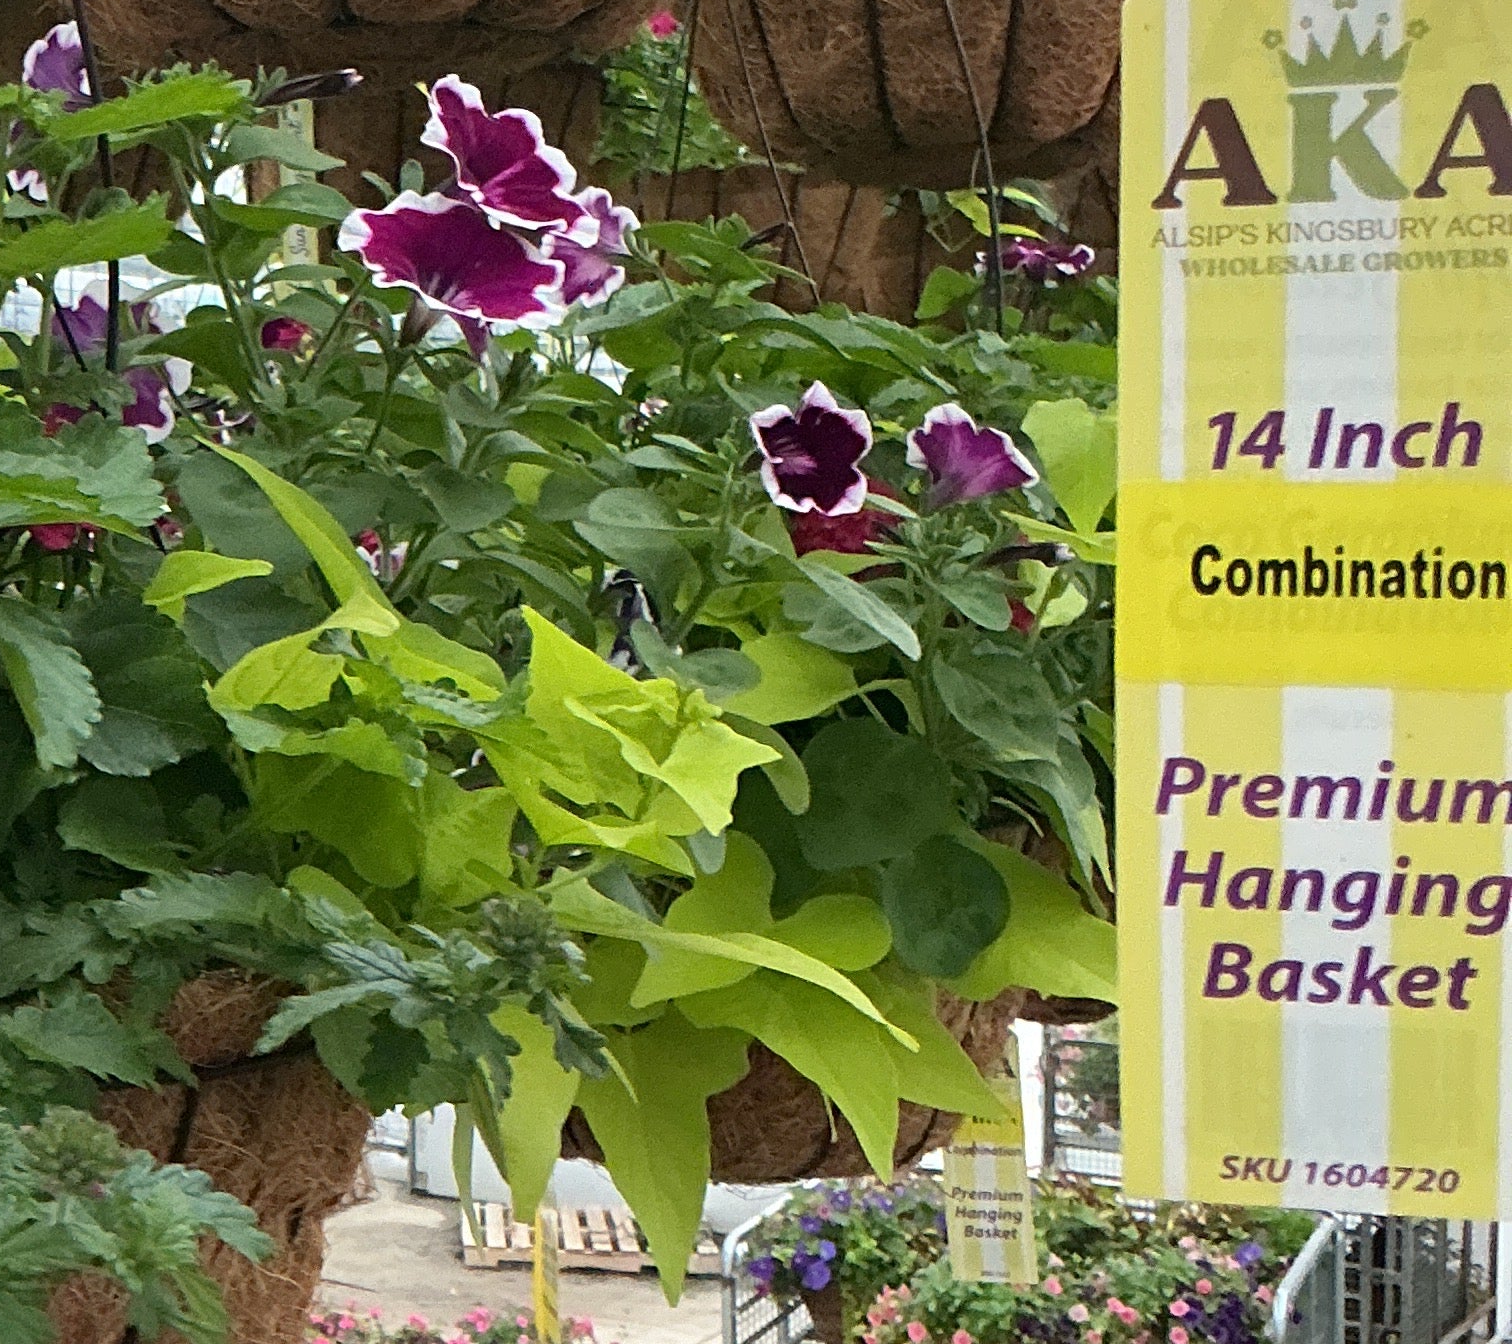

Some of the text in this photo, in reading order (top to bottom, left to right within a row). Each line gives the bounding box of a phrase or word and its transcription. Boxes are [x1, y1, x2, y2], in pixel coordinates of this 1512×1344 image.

[1150, 83, 1512, 210] AKA
[1150, 212, 1512, 249] ALSIP'S KINGSBURY ACR
[1179, 247, 1510, 279] WHOLESALE GROWERS
[1207, 402, 1484, 471] 14 Inch
[1190, 545, 1506, 601] Combination
[1155, 756, 1512, 825] Premium
[1163, 850, 1512, 936] Hanging
[1202, 942, 1479, 1011] Basket
[952, 1186, 1024, 1202] Premium
[1219, 1155, 1461, 1195] SKU 1604720
[955, 1206, 1023, 1224] Hanging
[964, 1225, 1017, 1240] Basket
